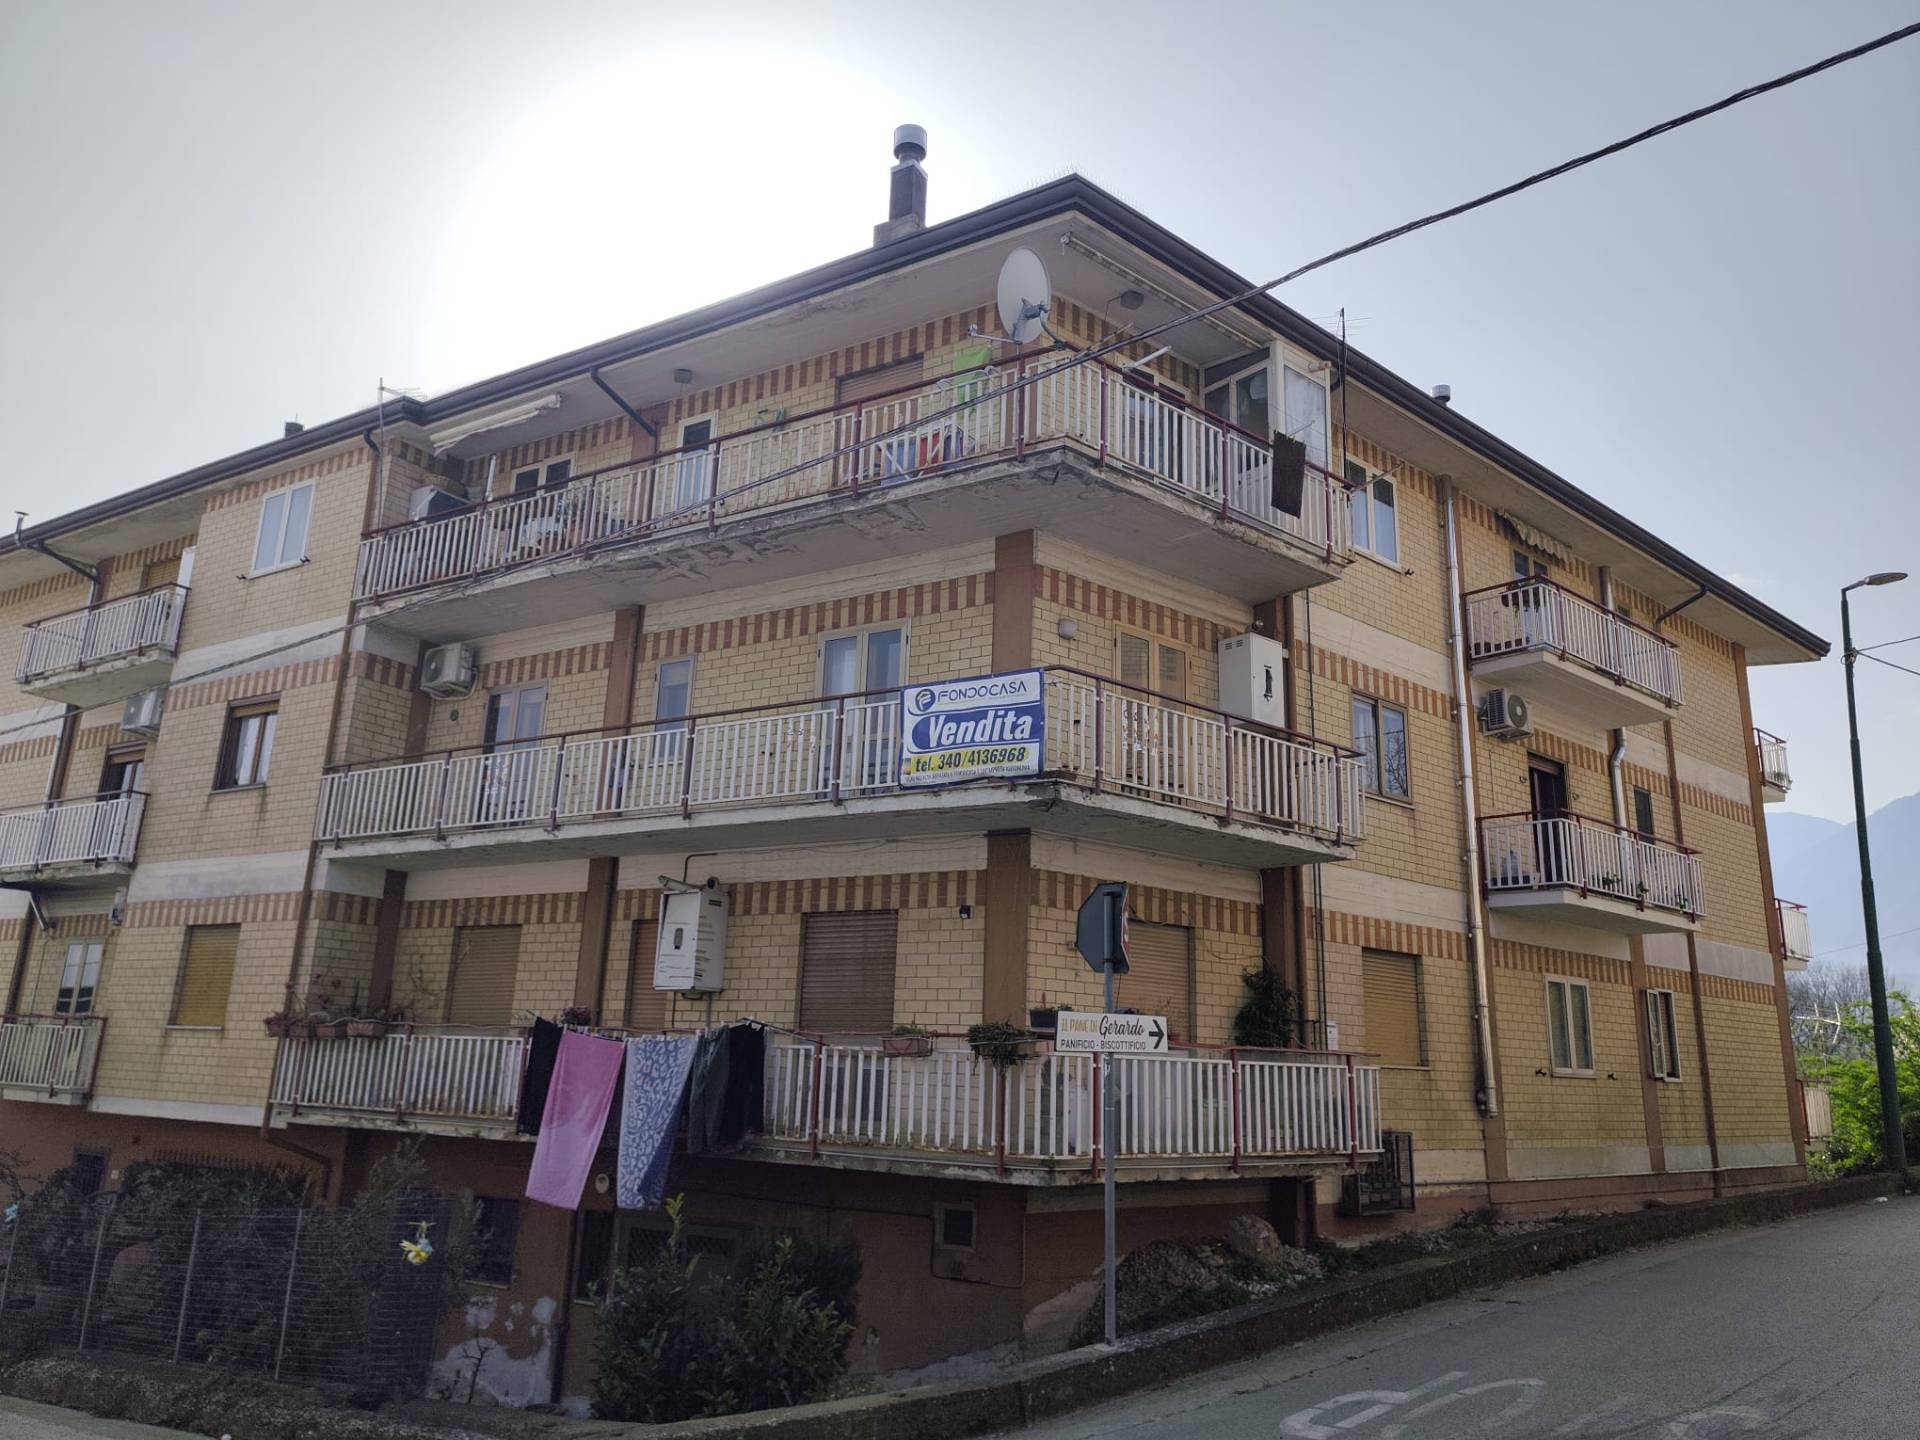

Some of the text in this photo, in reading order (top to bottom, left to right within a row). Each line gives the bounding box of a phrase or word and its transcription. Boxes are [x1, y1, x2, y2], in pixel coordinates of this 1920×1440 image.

[938, 681, 1027, 702] FONDOCASA
[929, 710, 1033, 747] Vendita
[916, 746, 1027, 771] tel. 340/4136968
[1099, 1015, 1145, 1039] Gerardo
[1060, 1039, 1095, 1050] PANIFICIO
[1100, 1040, 1146, 1050] BISCOTTIFICIO
